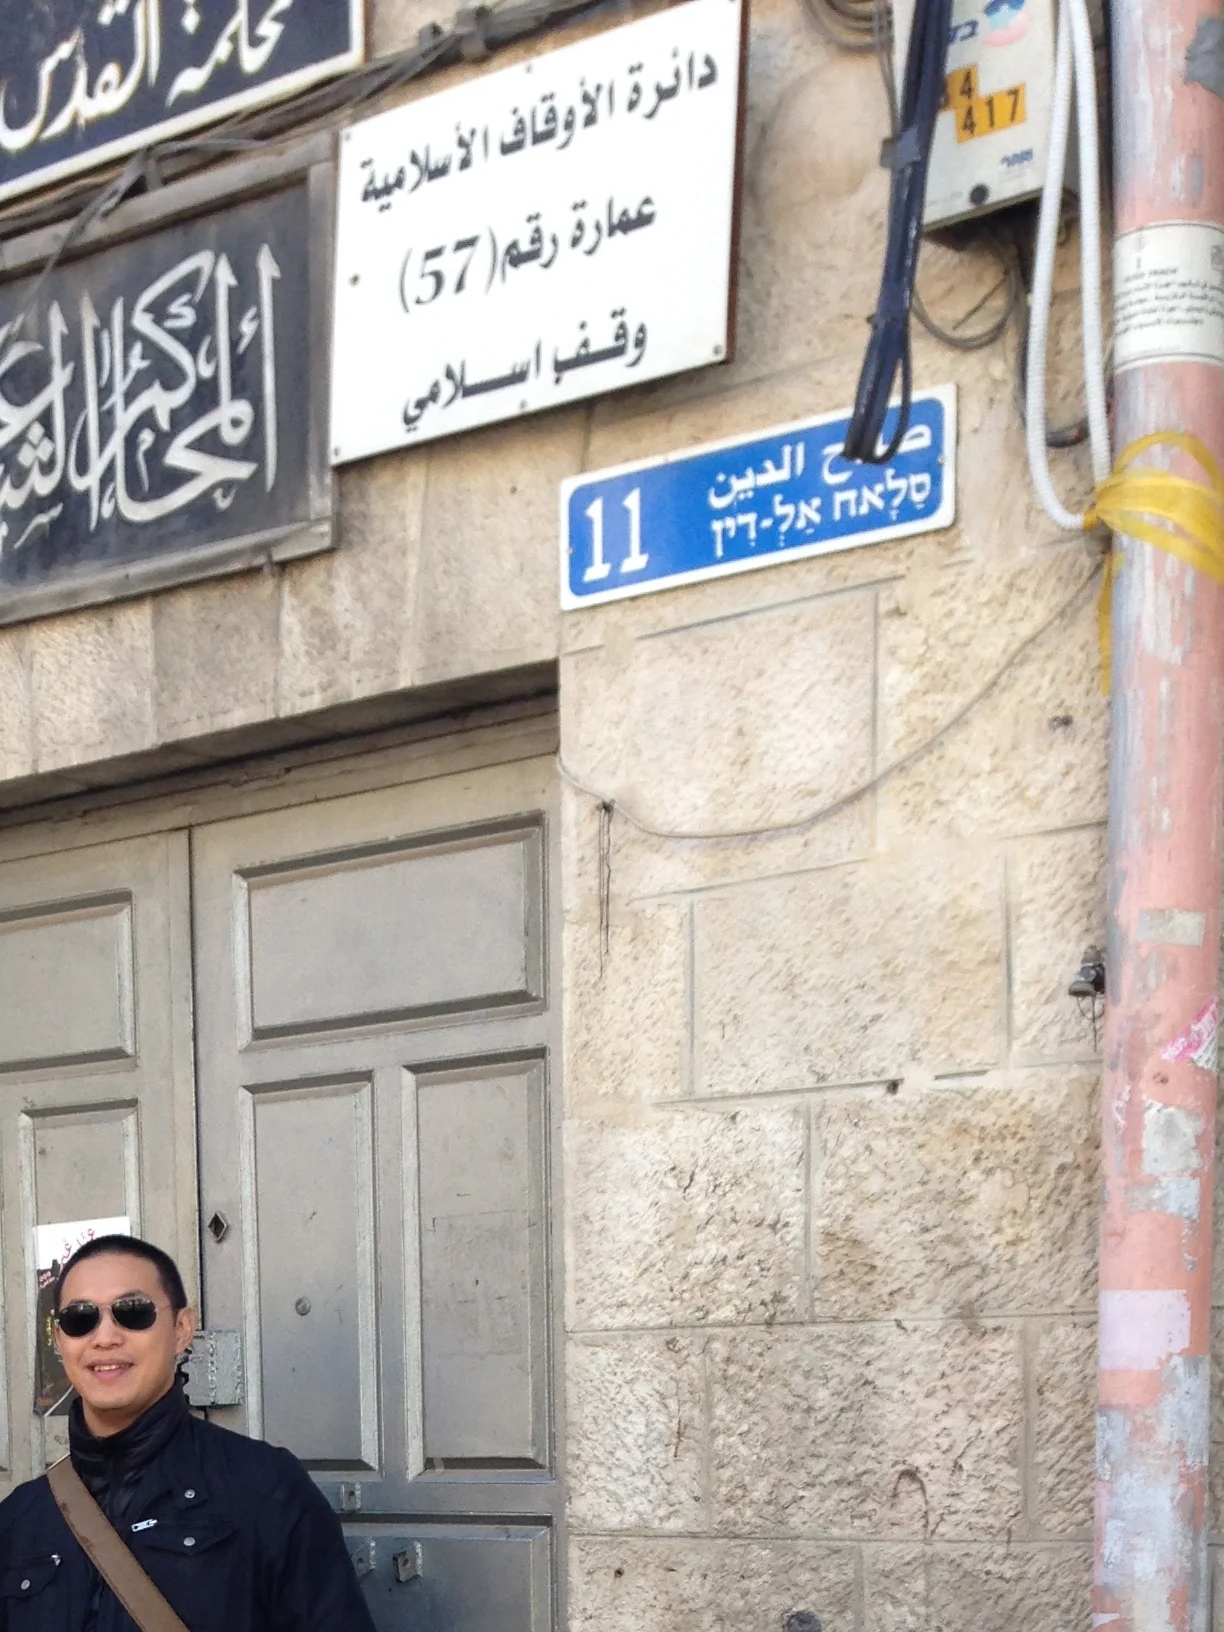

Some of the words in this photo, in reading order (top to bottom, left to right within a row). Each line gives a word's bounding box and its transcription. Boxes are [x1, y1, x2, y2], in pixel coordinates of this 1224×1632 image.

[498, 76, 618, 157] الأوقاف
[627, 46, 718, 121] دائرة
[963, 87, 1022, 135] 417
[499, 211, 558, 285] رقم
[570, 196, 656, 256] عمارة
[399, 224, 498, 314] (57)
[552, 306, 648, 387] وقف
[401, 338, 542, 434] اسلامي
[707, 440, 806, 510] الدين
[583, 486, 650, 583] 11
